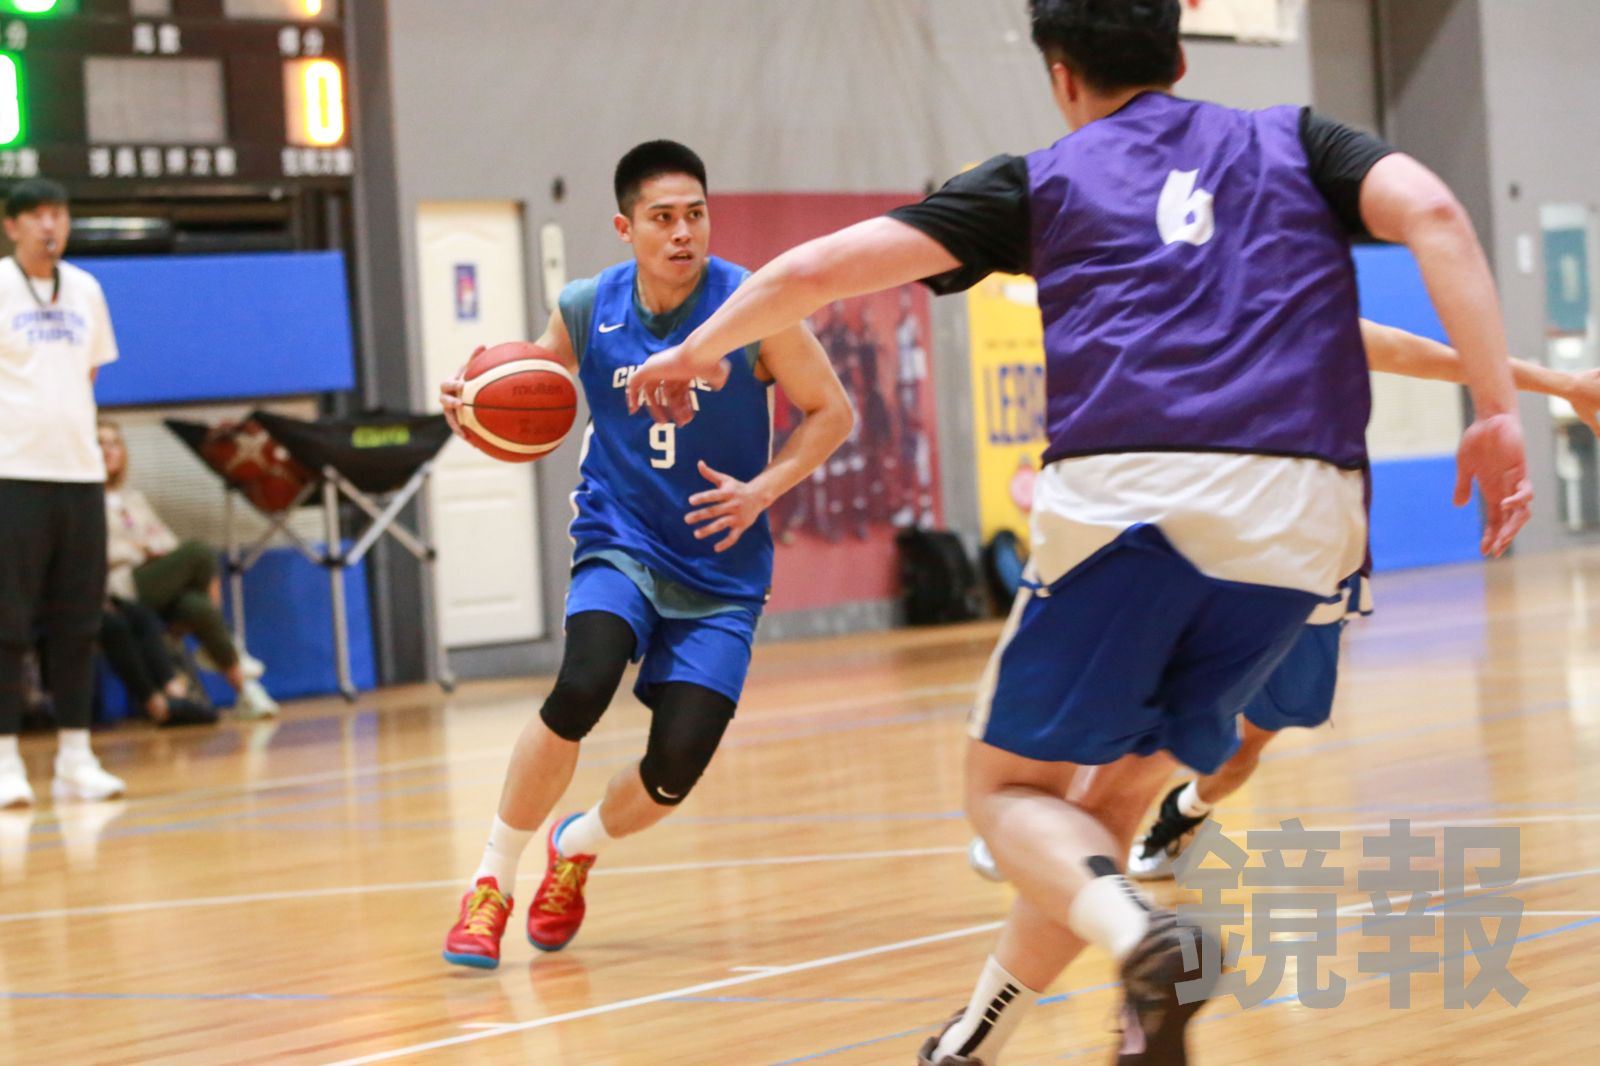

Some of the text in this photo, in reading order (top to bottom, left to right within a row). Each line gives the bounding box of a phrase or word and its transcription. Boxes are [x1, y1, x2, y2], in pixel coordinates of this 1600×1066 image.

[303, 59, 345, 147] 0
[1156, 168, 1215, 247] 6
[649, 422, 676, 469] 9
